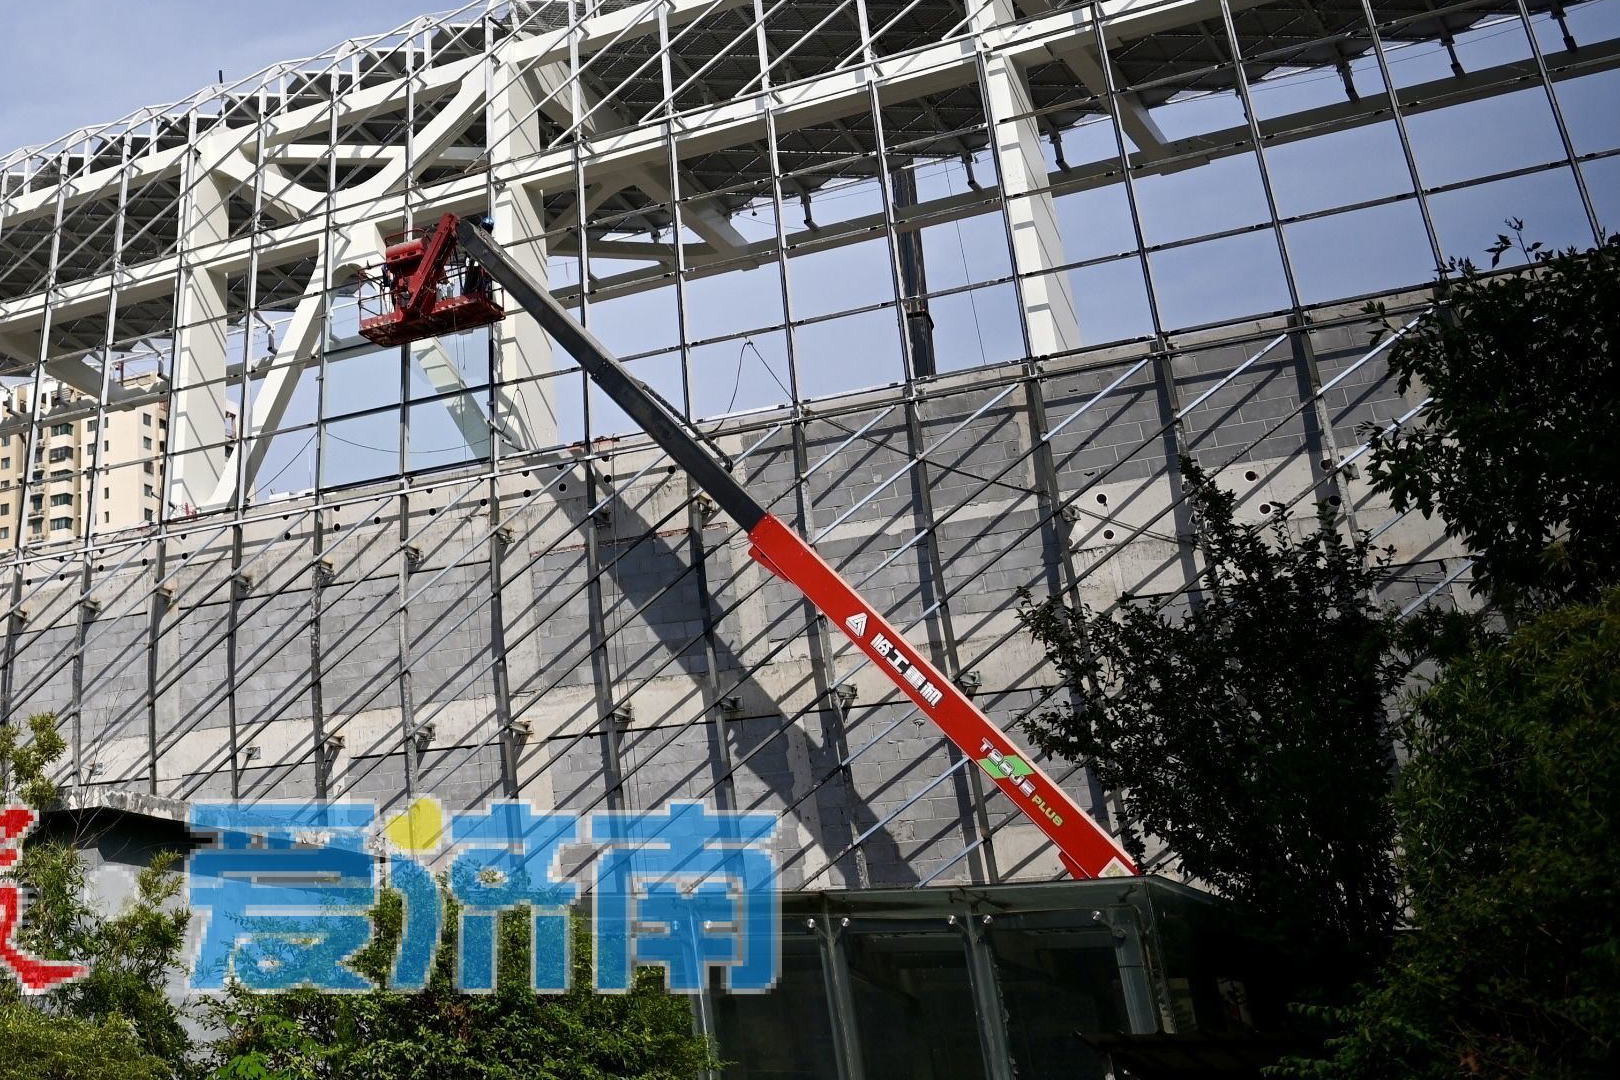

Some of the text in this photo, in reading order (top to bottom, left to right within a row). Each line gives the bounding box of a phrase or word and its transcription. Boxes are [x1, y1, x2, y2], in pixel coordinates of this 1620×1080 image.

[871, 633, 943, 707] 临工重机
[979, 738, 1063, 827] T28JE PLUS
